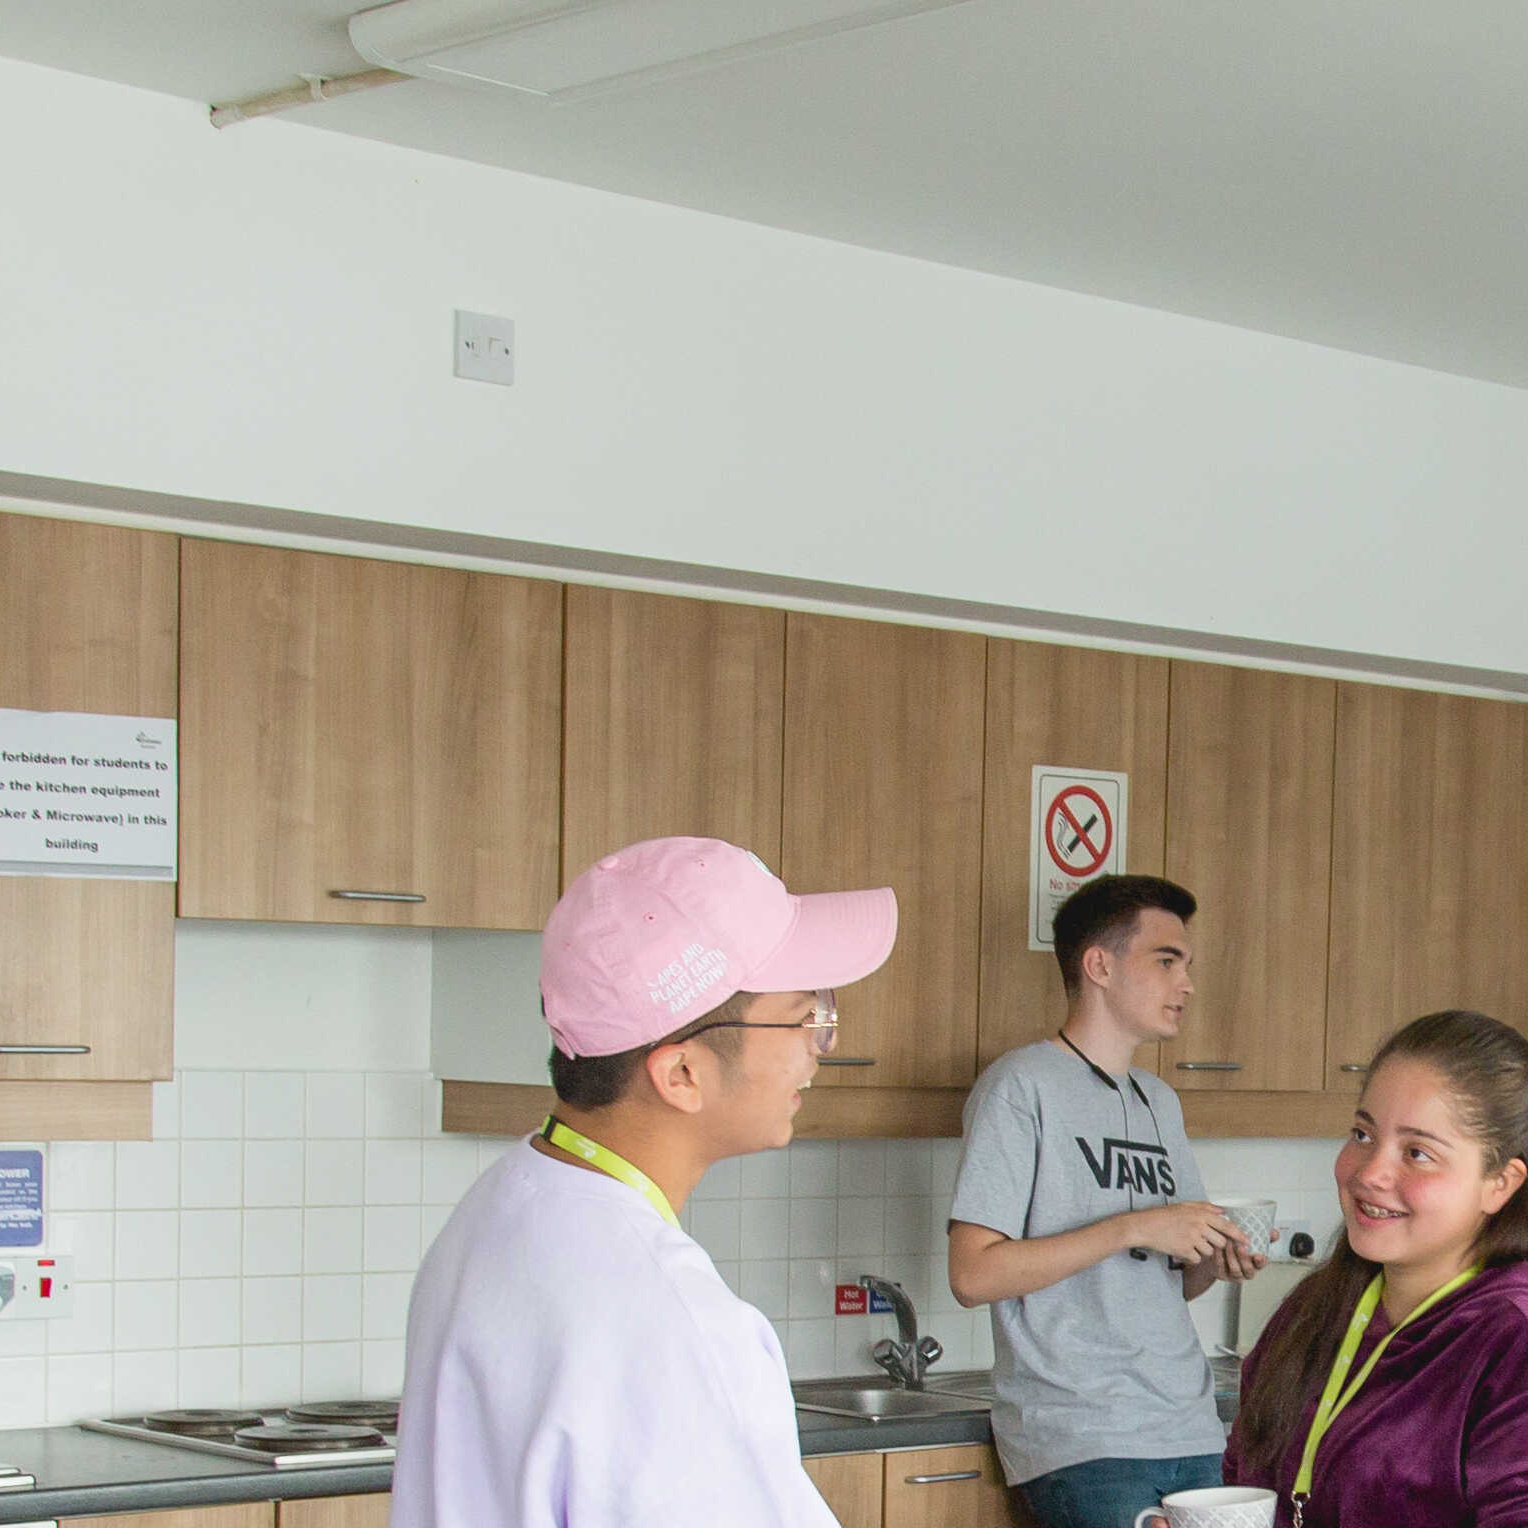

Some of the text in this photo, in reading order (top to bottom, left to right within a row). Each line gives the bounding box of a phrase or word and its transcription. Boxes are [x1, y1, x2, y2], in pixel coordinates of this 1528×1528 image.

[2, 750, 67, 766] forbidden
[70, 755, 90, 767] for
[93, 756, 151, 771] students
[155, 759, 169, 771] to
[9, 779, 32, 791] the
[35, 781, 87, 795] kitchen
[91, 784, 161, 799] equipment
[32, 808, 42, 820] &
[46, 809, 124, 826] Microwave)
[127, 813, 140, 825] in
[144, 813, 168, 826] this
[45, 838, 99, 853] building
[1074, 1135, 1177, 1197] VANS
[844, 1290, 859, 1299] Hot
[839, 1301, 864, 1311] Water
